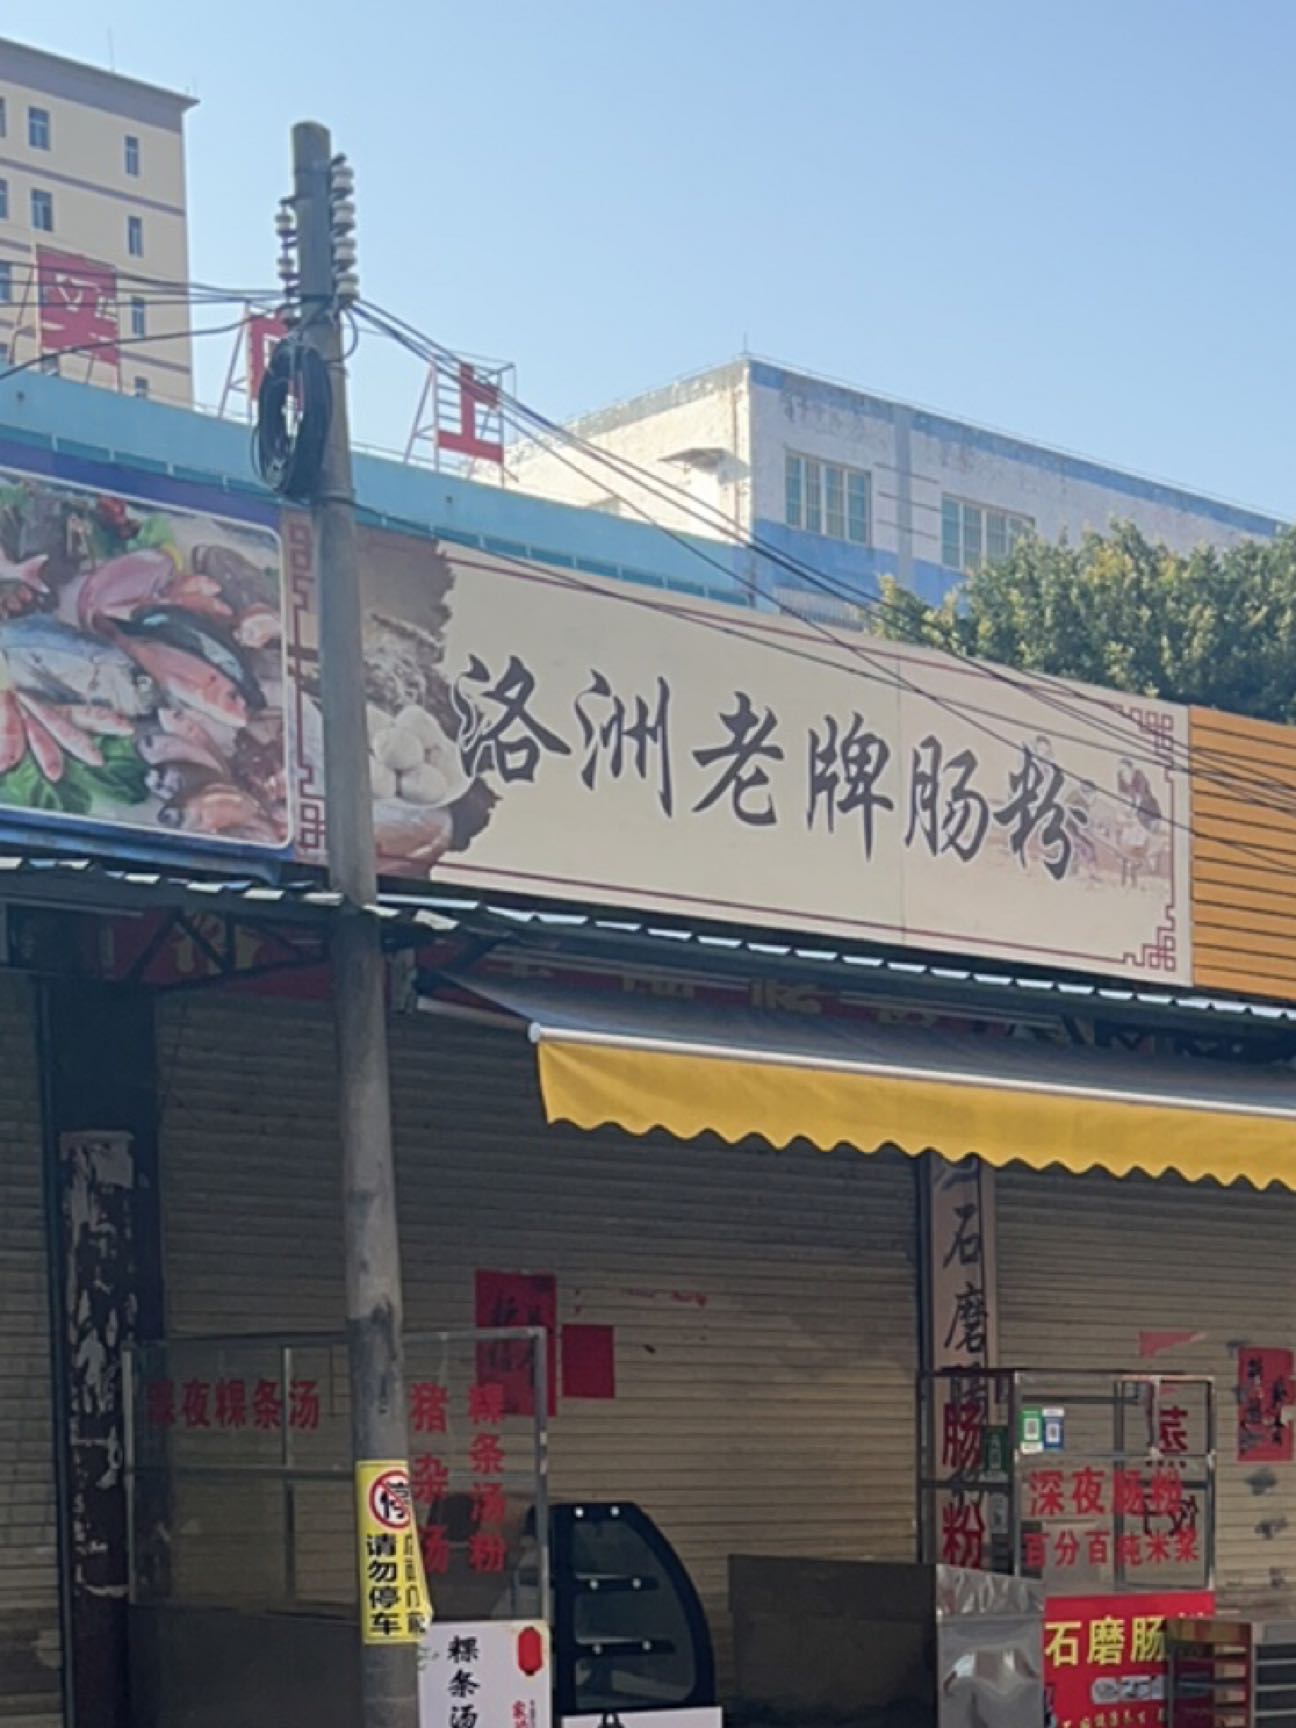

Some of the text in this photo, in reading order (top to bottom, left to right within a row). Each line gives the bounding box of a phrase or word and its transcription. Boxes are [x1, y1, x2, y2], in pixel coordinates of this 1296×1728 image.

[452, 654, 1088, 880] 洛洲老牌肠粉
[467, 1382, 507, 1574] 粿条汤粉
[1028, 1466, 1184, 1516] 深夜肠粉
[367, 1534, 403, 1637] 请勿停车
[1024, 1527, 1200, 1571] 百分百纯米浆
[1044, 1614, 1178, 1667] 石磨肠
